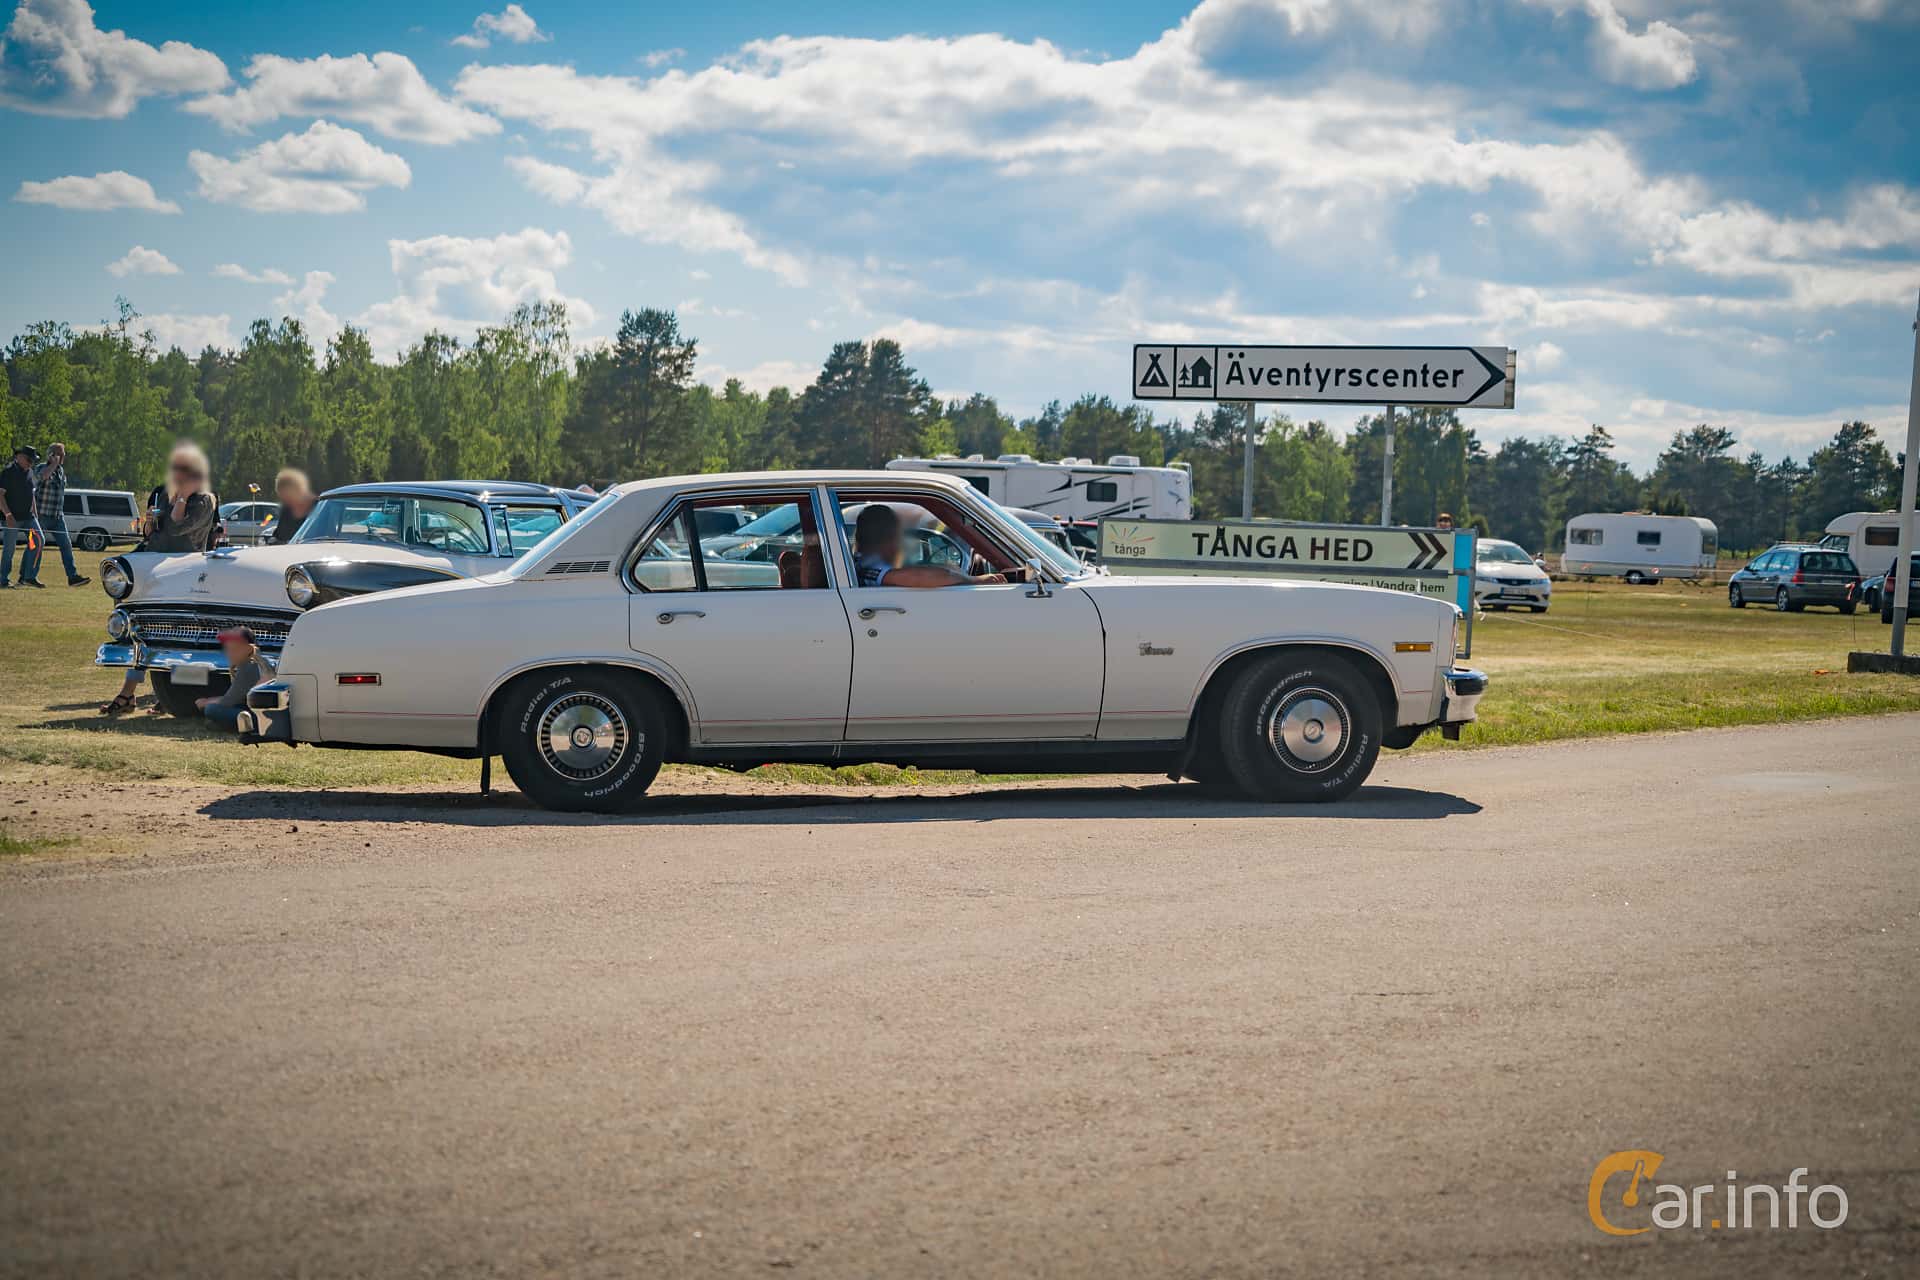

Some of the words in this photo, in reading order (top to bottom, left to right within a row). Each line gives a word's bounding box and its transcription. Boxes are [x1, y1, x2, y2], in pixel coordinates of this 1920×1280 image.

[1225, 351, 1464, 392] Äventyrscenter
[1192, 526, 1299, 560] TÅNGA
[1310, 536, 1374, 562] HED
[1376, 580, 1445, 593] Vandrahem
[520, 689, 548, 733] Radial
[549, 676, 573, 689] T/A
[1343, 733, 1369, 778] Radial
